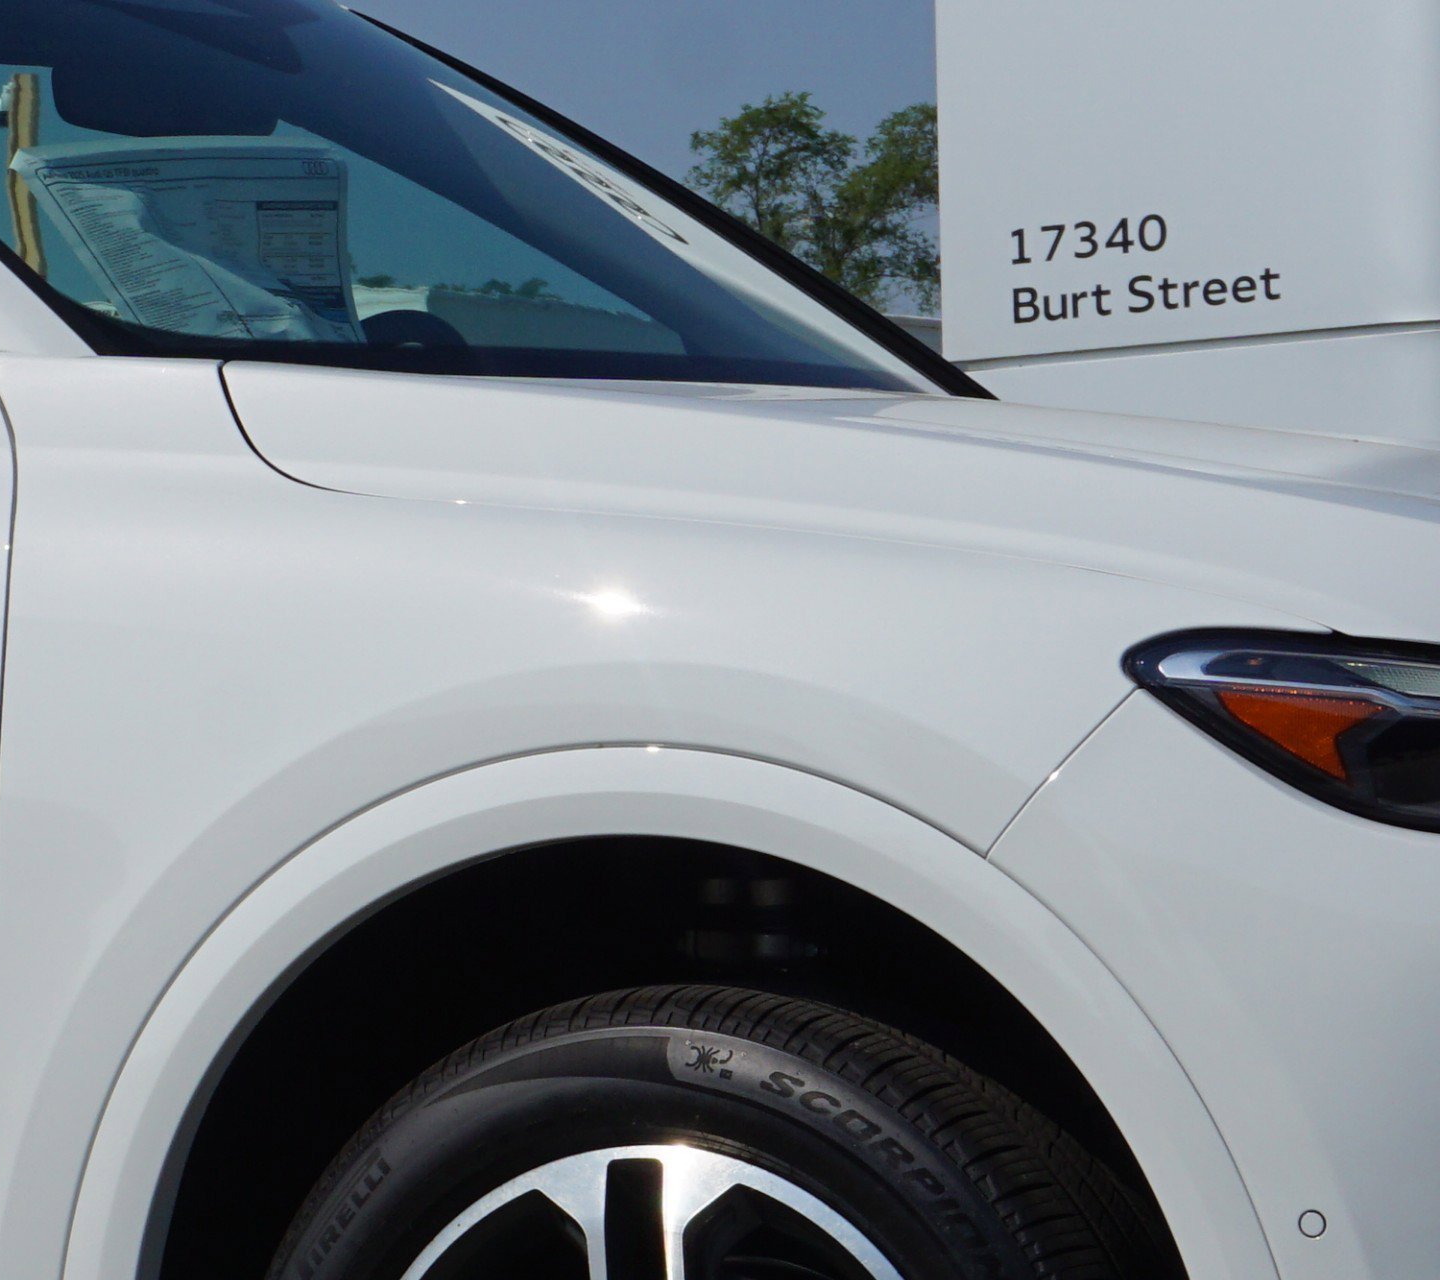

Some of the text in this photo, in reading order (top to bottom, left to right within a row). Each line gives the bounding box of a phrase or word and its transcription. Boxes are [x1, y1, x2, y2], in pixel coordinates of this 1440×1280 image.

[1010, 213, 1168, 265] 17340
[1012, 267, 1282, 324] Burt Street
